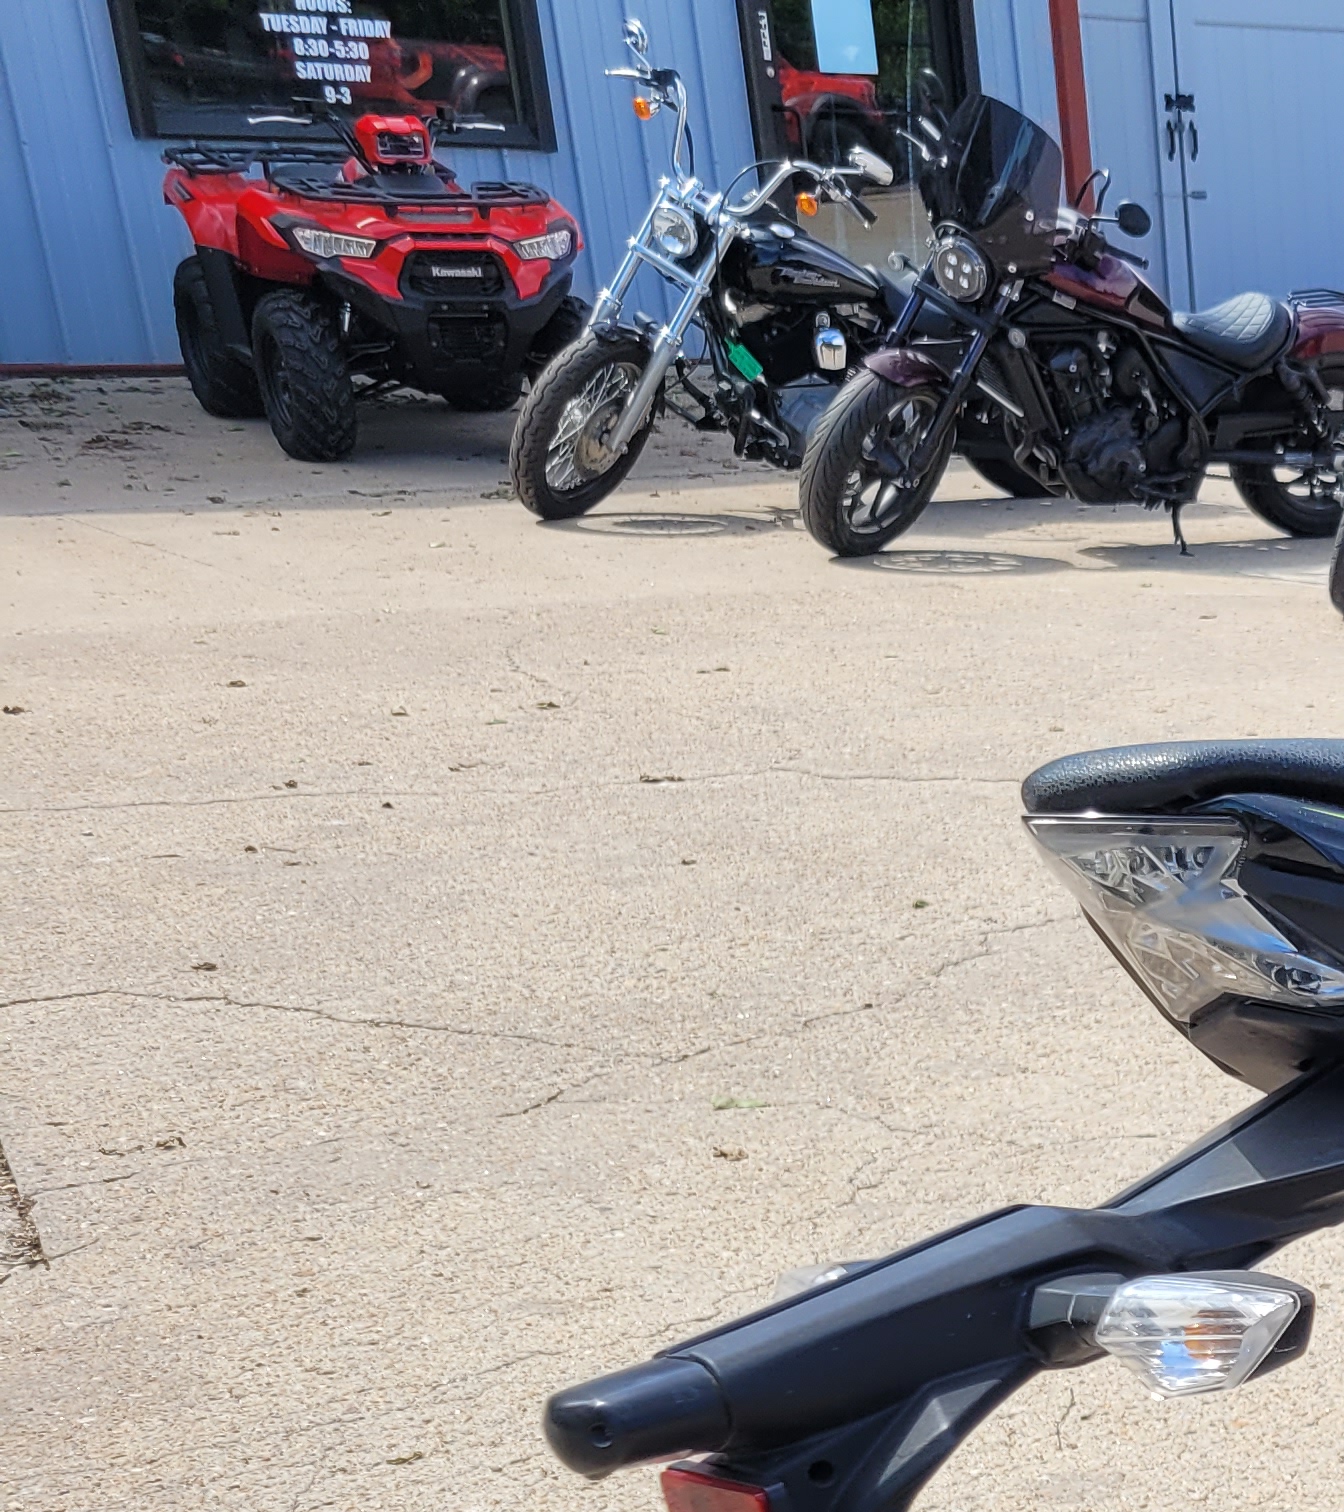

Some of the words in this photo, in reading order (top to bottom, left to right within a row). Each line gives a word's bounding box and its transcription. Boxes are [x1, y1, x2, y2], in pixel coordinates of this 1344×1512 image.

[260, 13, 327, 34] TUESDAY
[339, 17, 391, 38] FRIDAY
[293, 37, 369, 60] 8:30-5:30
[295, 61, 371, 83] SATURDAY
[324, 85, 352, 104] 9-3
[431, 265, 482, 278] Kawasaki
